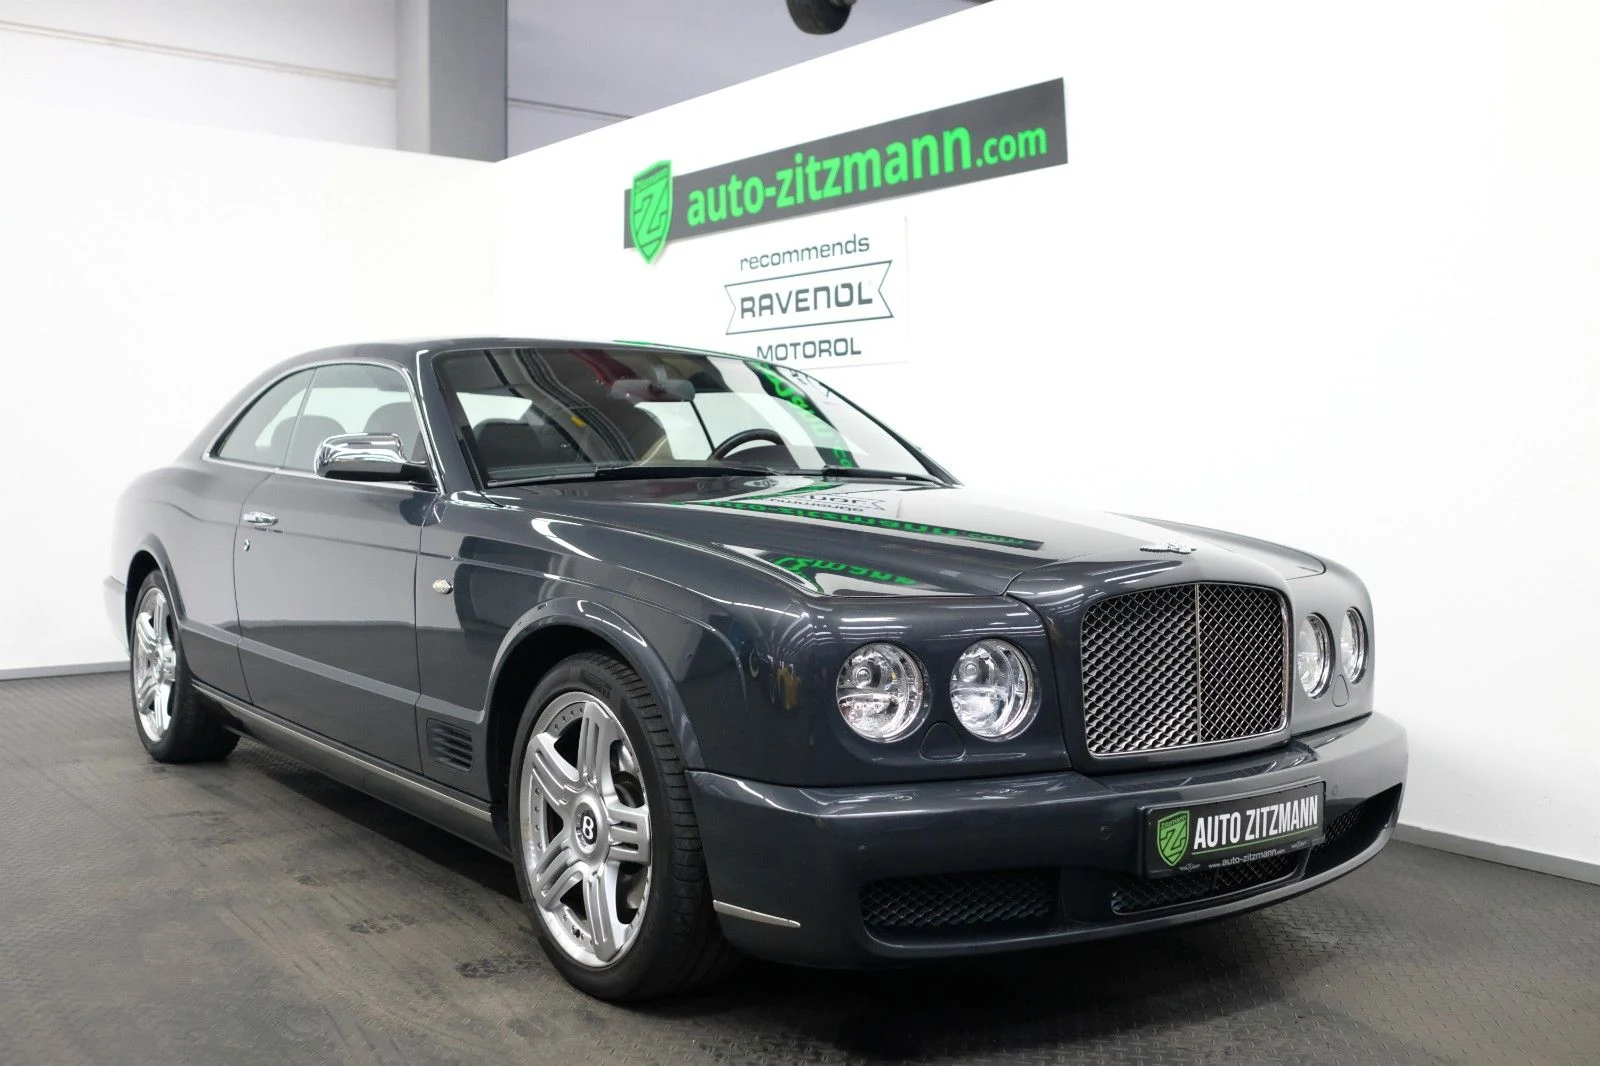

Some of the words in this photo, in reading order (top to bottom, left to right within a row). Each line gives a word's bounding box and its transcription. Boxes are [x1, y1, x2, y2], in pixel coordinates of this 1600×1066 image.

[686, 126, 1048, 226] auto-zitzmann.com
[740, 233, 870, 271] recommends
[740, 281, 873, 319] RAVENOL
[756, 337, 862, 361] MOTOROL
[1193, 812, 1241, 850] AUTO
[1244, 795, 1319, 841] ZITZMANN
